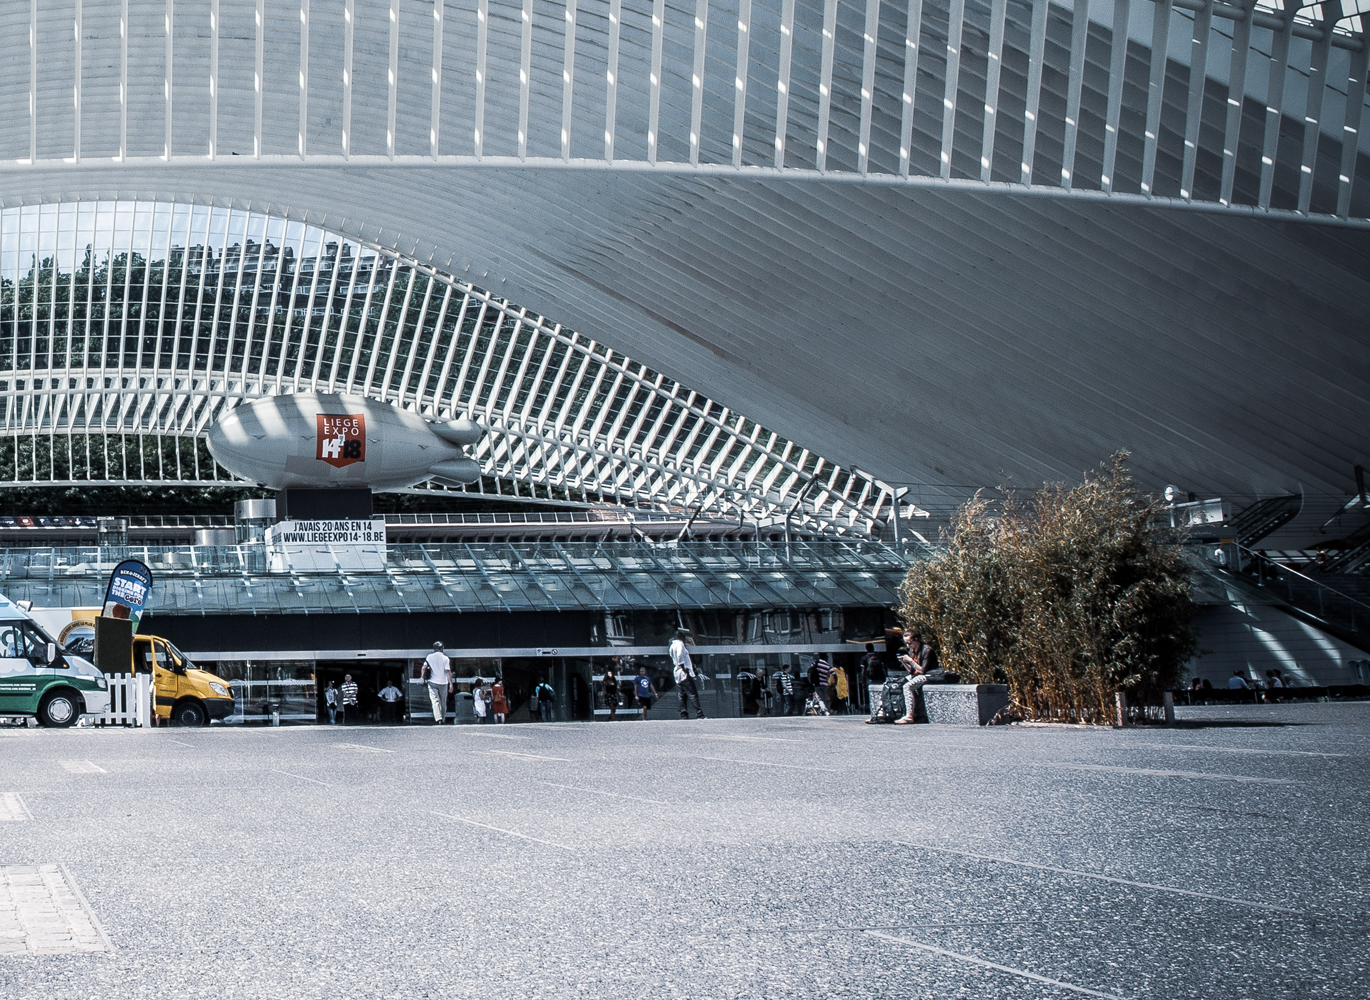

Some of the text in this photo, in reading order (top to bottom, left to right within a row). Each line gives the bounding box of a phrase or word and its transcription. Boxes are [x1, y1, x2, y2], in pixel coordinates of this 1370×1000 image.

[323, 418, 359, 427] LIEGE
[323, 426, 359, 436] EXPO
[293, 521, 373, 532] J'AVAIS 20 ANS EN 14
[113, 577, 147, 596] START
[111, 589, 125, 598] THE
